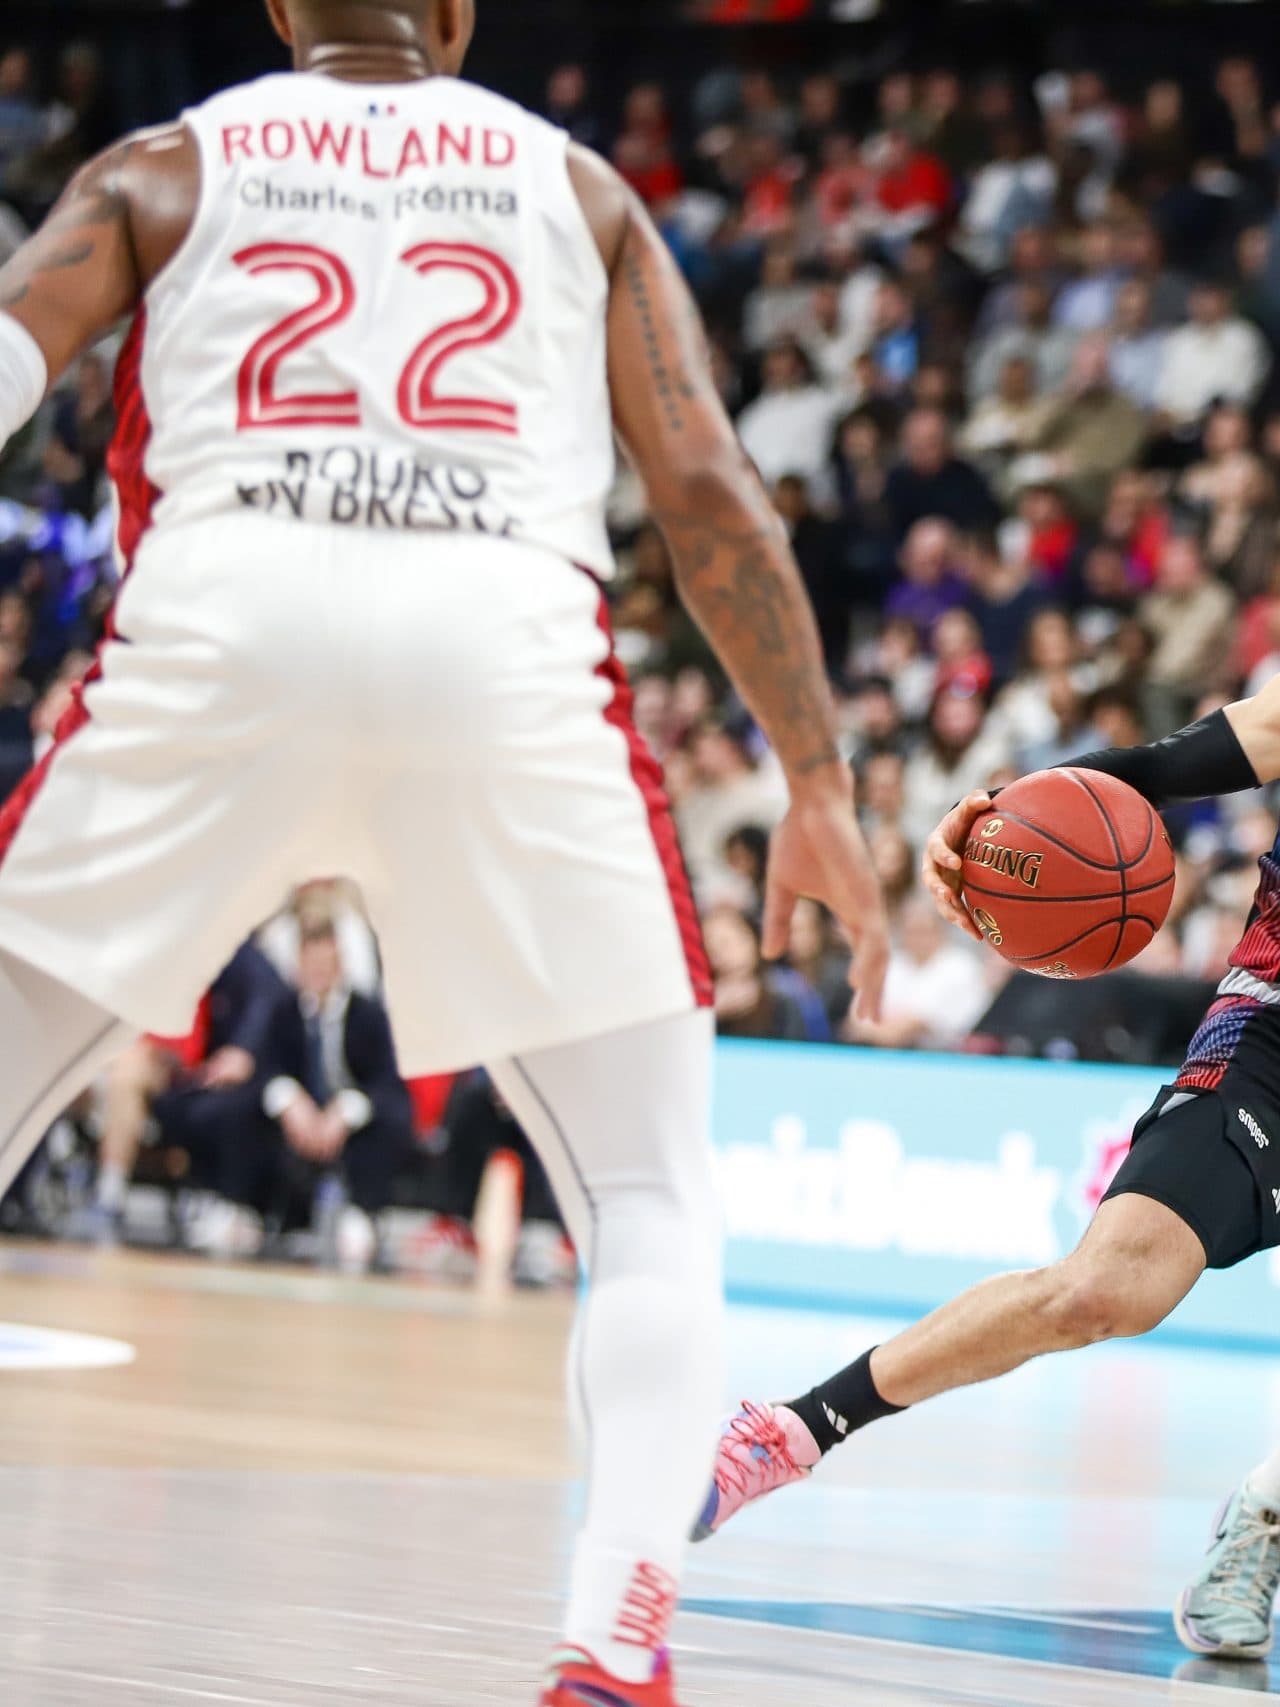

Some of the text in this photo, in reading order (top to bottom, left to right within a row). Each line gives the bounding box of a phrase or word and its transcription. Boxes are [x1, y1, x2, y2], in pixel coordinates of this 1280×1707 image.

[221, 117, 516, 179] ROWLAND
[240, 178, 518, 219] Charles Réma
[231, 241, 521, 434] 22
[1237, 1107, 1270, 1149] snipes
